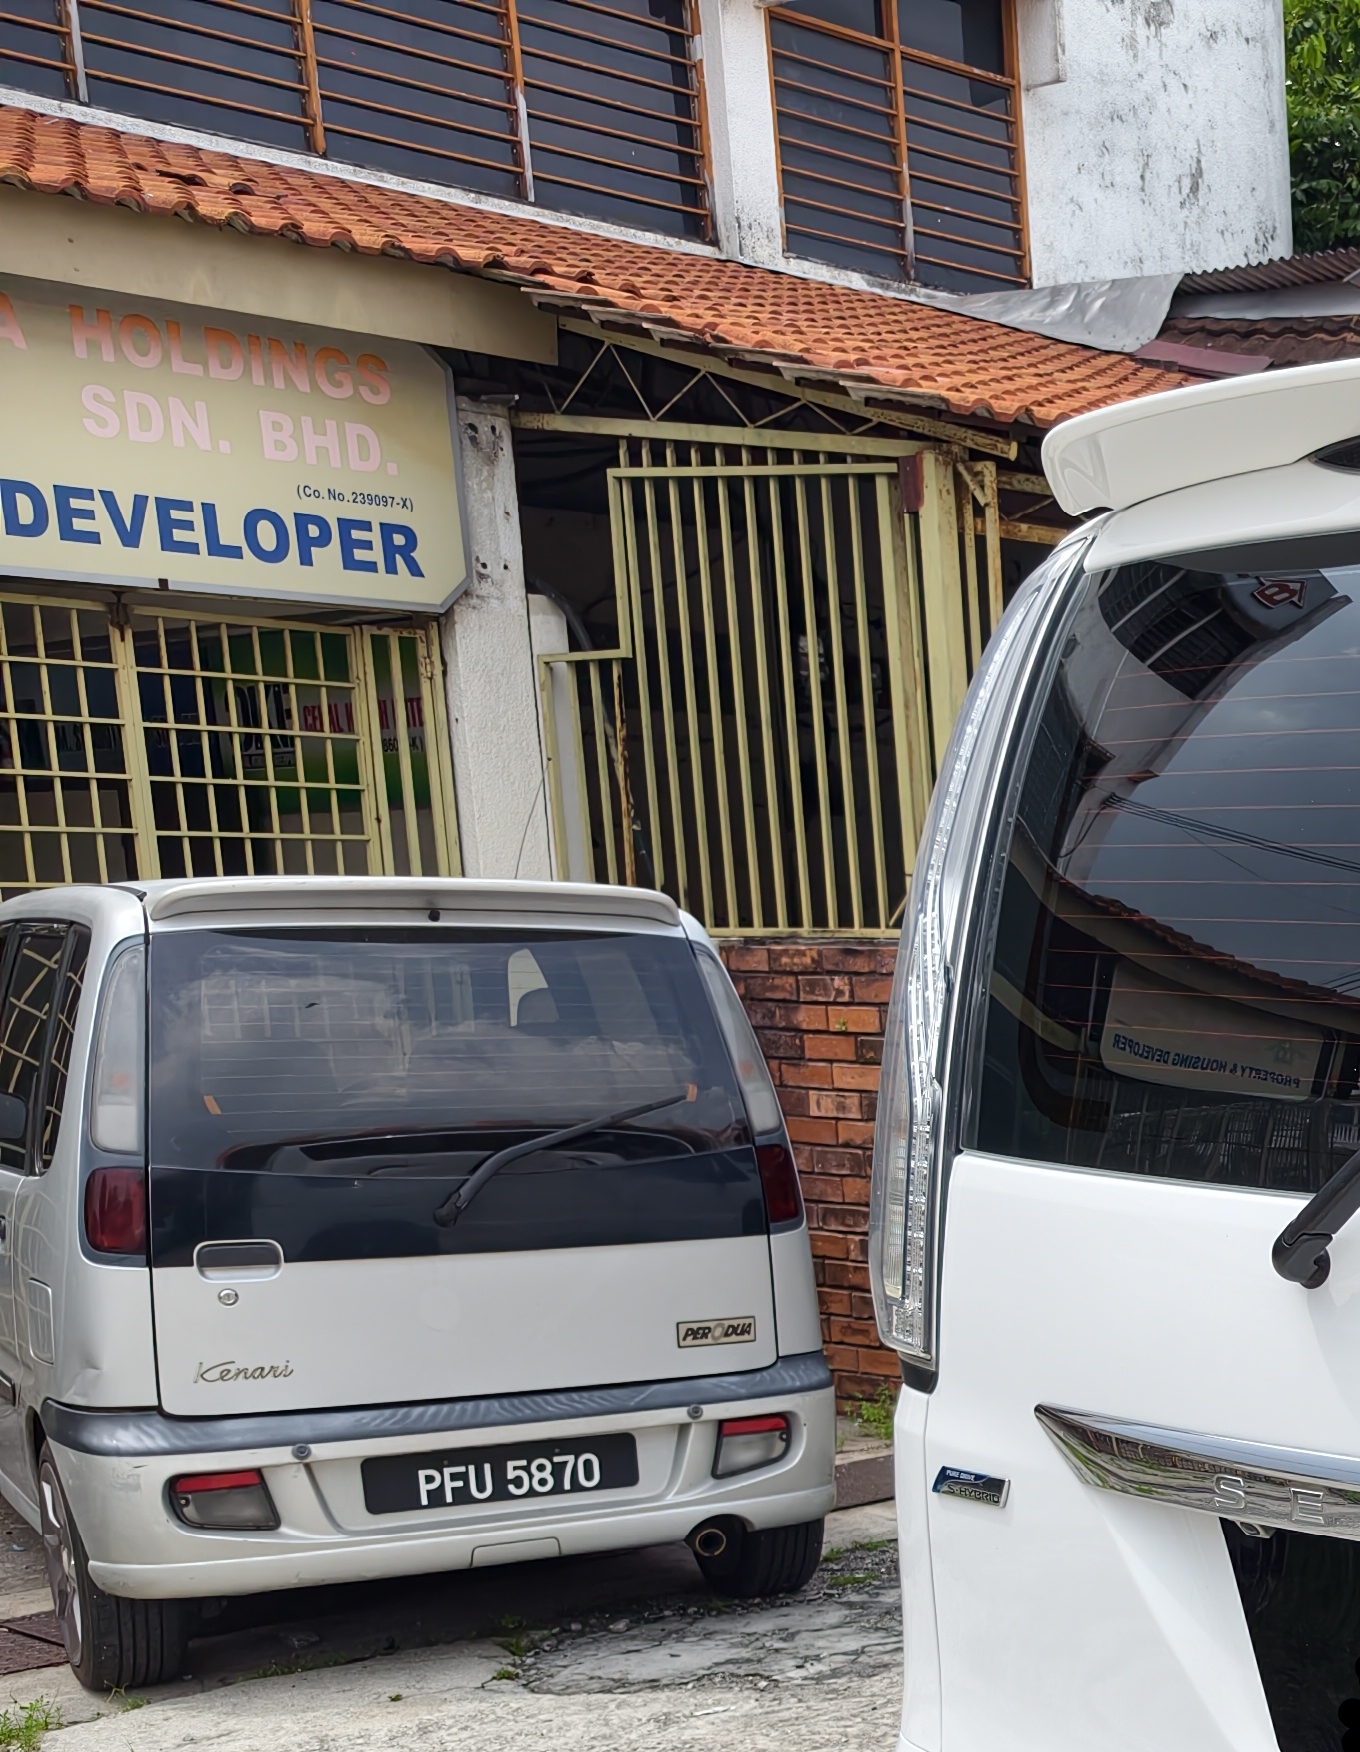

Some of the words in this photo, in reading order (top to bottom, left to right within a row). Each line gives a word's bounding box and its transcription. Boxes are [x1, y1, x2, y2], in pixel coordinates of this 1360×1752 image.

[68, 304, 392, 405] HOLDINGS
[81, 384, 232, 454] SDN.
[259, 409, 399, 476] BHD.
[0, 478, 425, 578] DEVELOPER
[682, 1322, 752, 1342] PERODUA
[193, 1359, 294, 1383] Kenari
[418, 1462, 494, 1506] PFU
[506, 1452, 601, 1496] 5870
